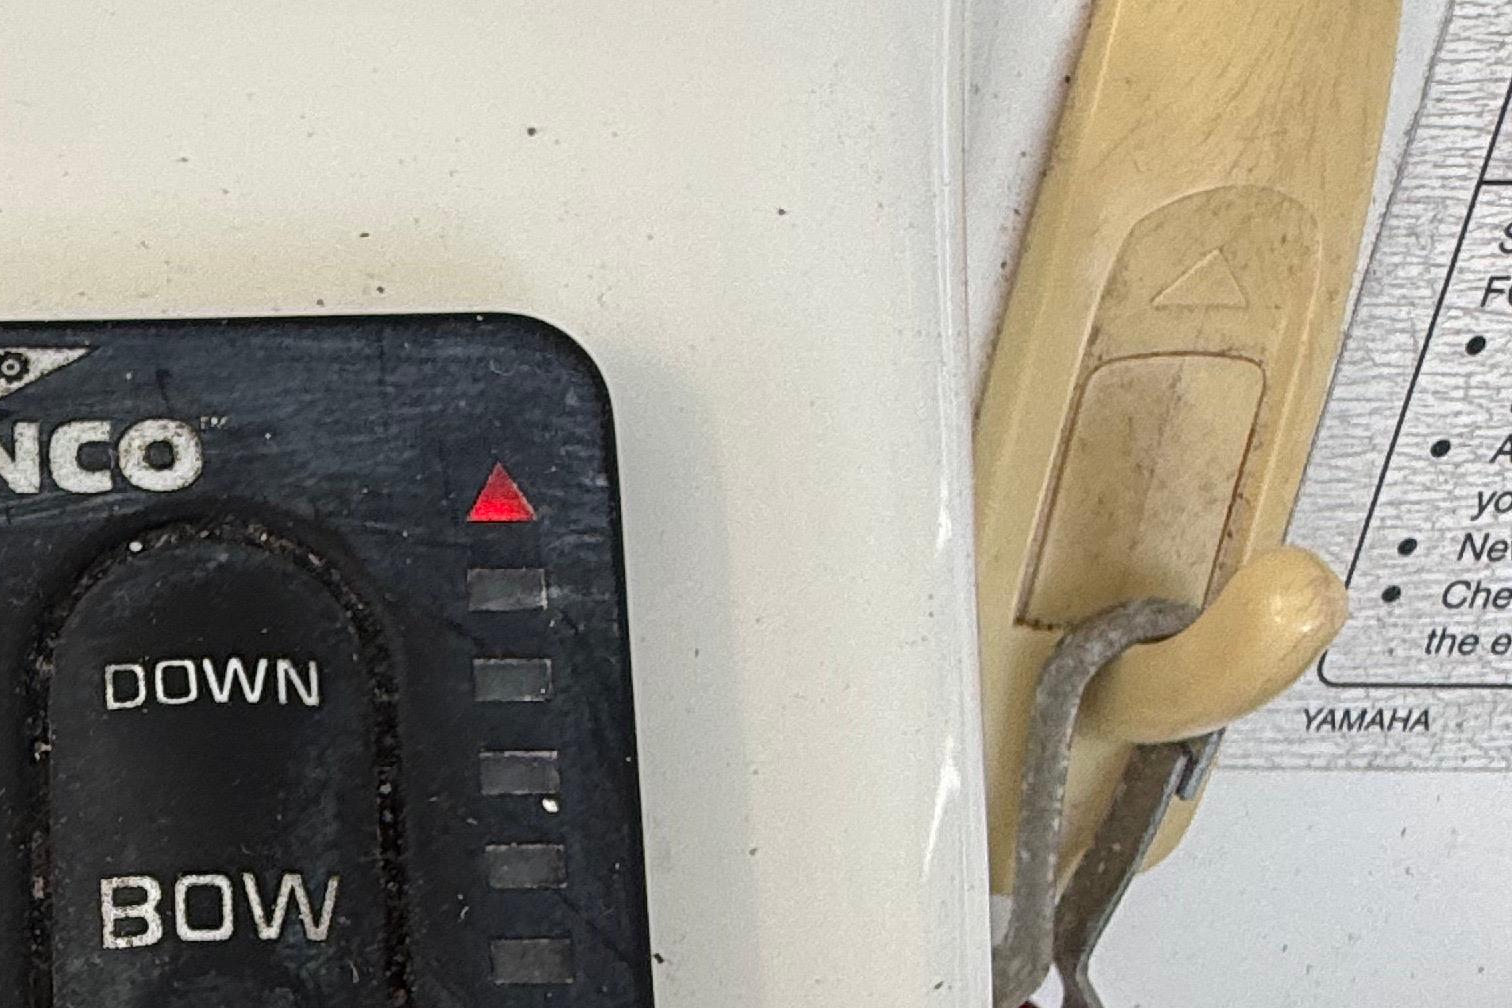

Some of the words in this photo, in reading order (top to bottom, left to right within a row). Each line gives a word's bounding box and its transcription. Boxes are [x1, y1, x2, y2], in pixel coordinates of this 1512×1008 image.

[1456, 532, 1512, 562] Ne
[1424, 626, 1480, 657] the
[104, 658, 320, 710] DOWN
[1303, 707, 1430, 732] YAMAHA
[100, 872, 339, 950] BOW
